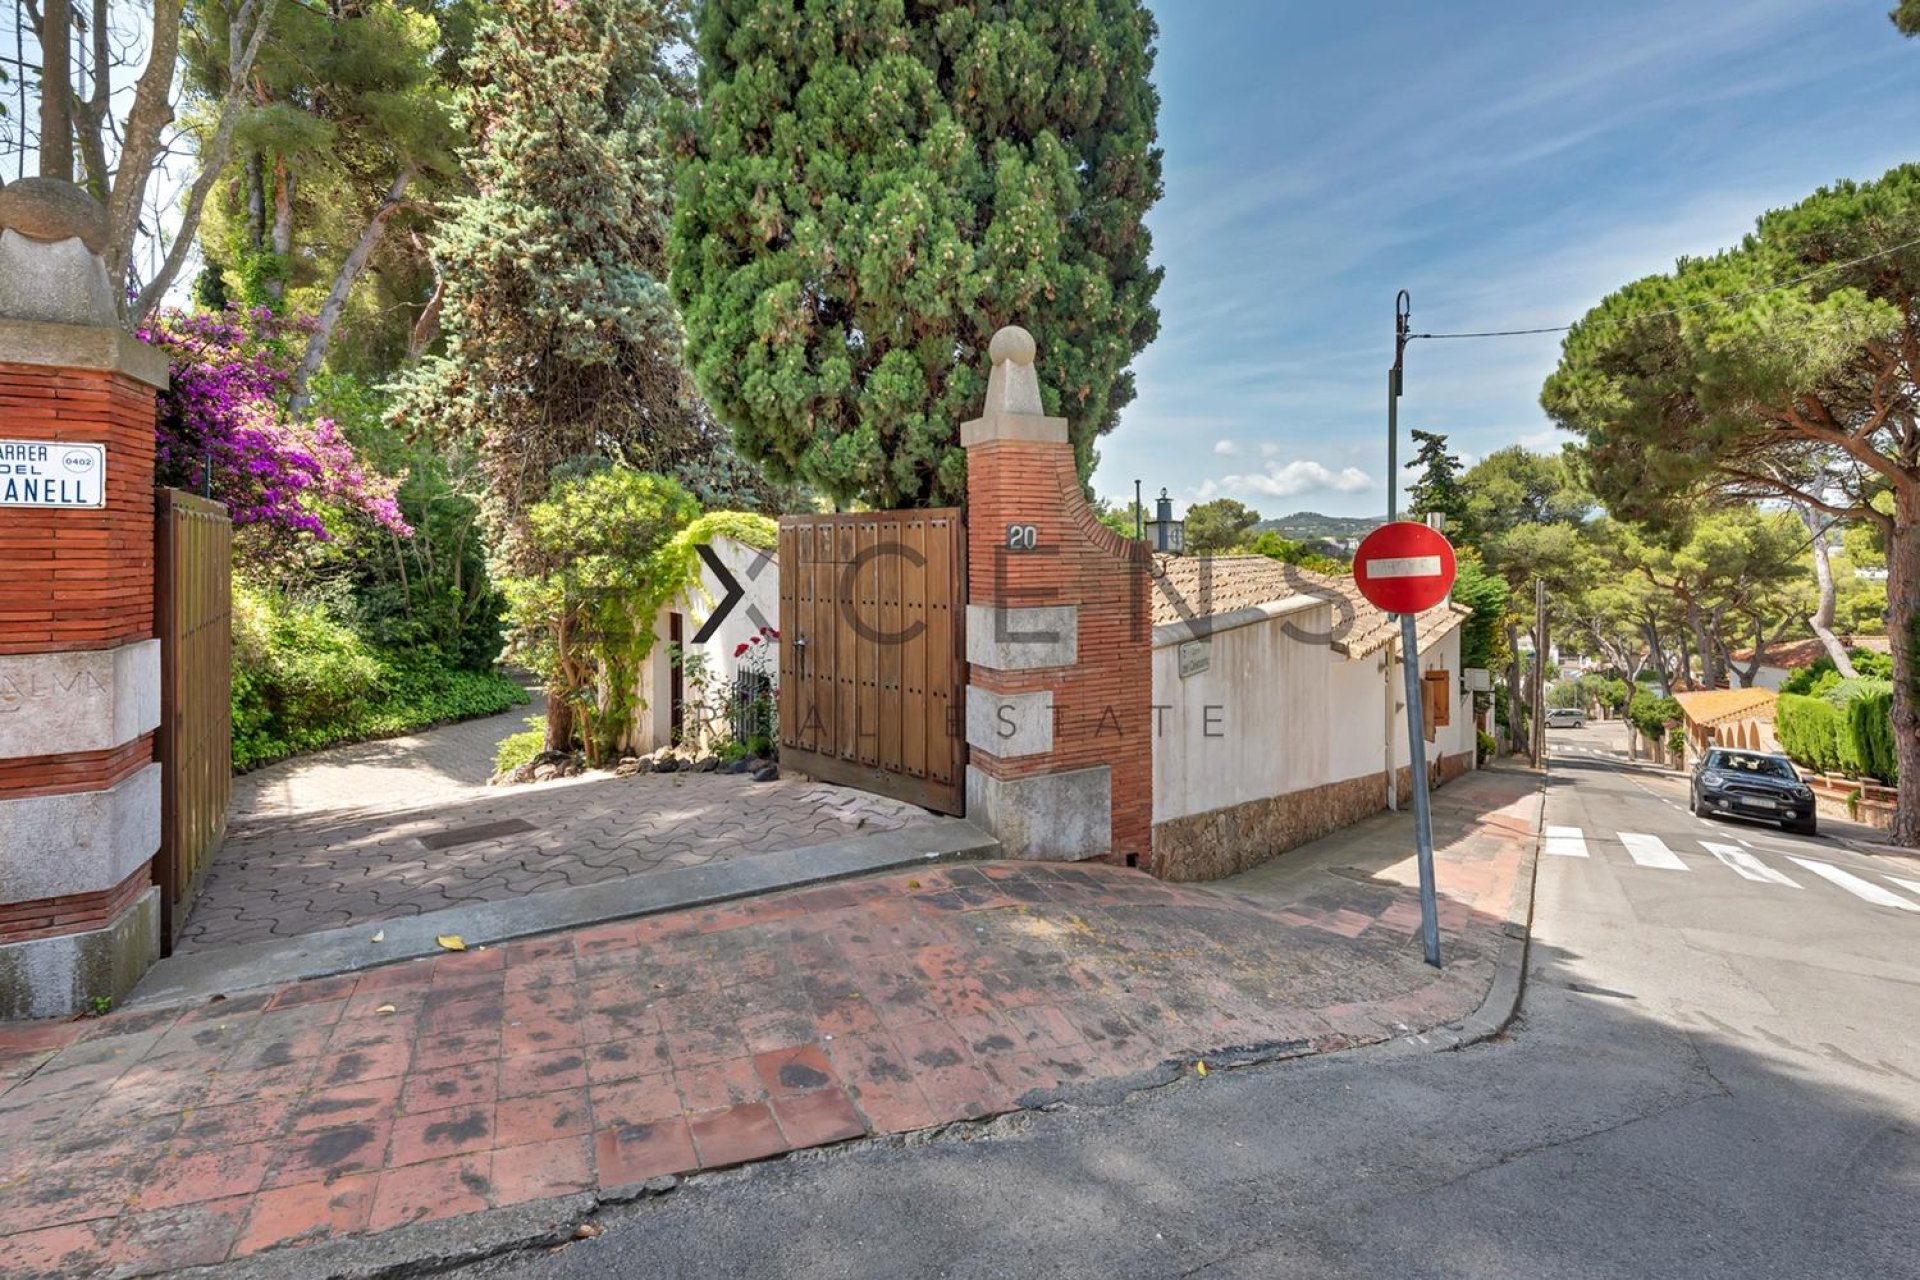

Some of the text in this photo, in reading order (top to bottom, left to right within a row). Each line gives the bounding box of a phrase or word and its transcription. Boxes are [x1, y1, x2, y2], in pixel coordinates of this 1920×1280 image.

[0, 464, 42, 475] DEL
[65, 458, 92, 466] 0402
[4, 478, 87, 503] ANELL
[1010, 525, 1037, 550] 20
